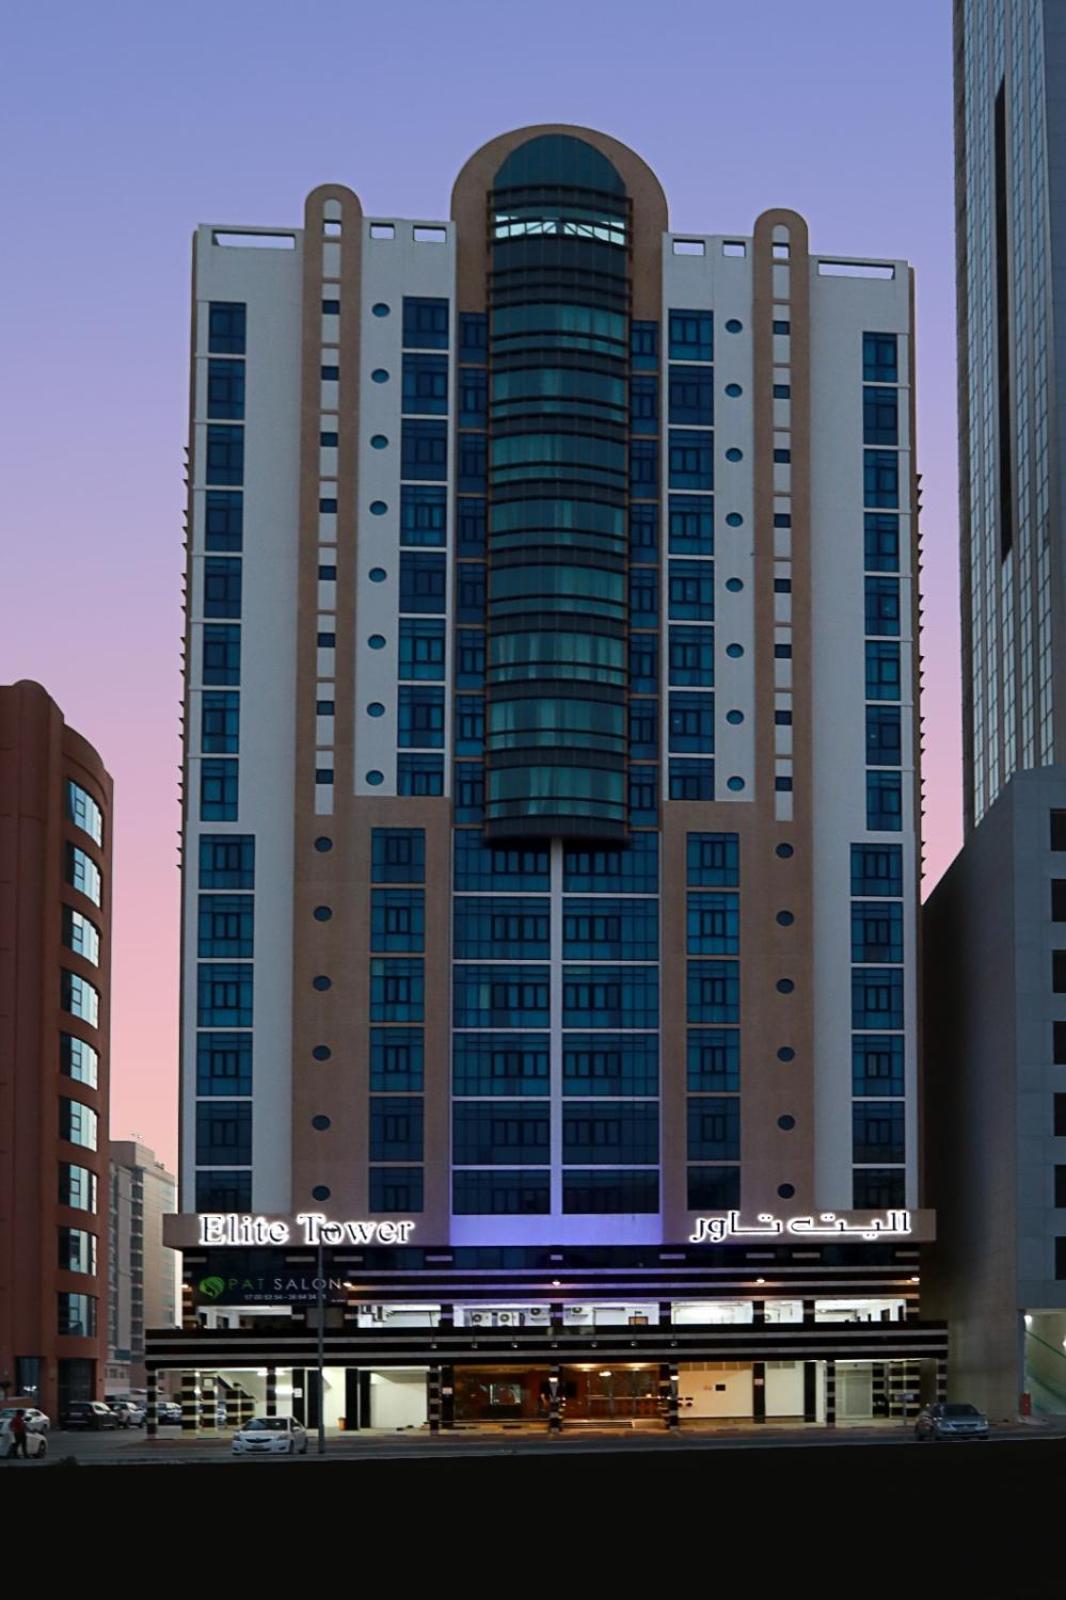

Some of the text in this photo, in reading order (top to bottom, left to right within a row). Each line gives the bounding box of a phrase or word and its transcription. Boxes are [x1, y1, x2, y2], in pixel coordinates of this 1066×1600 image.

[199, 1213, 414, 1245] Elite Tower
[690, 1210, 782, 1243] تاور
[228, 1278, 341, 1290] PAT SALON
